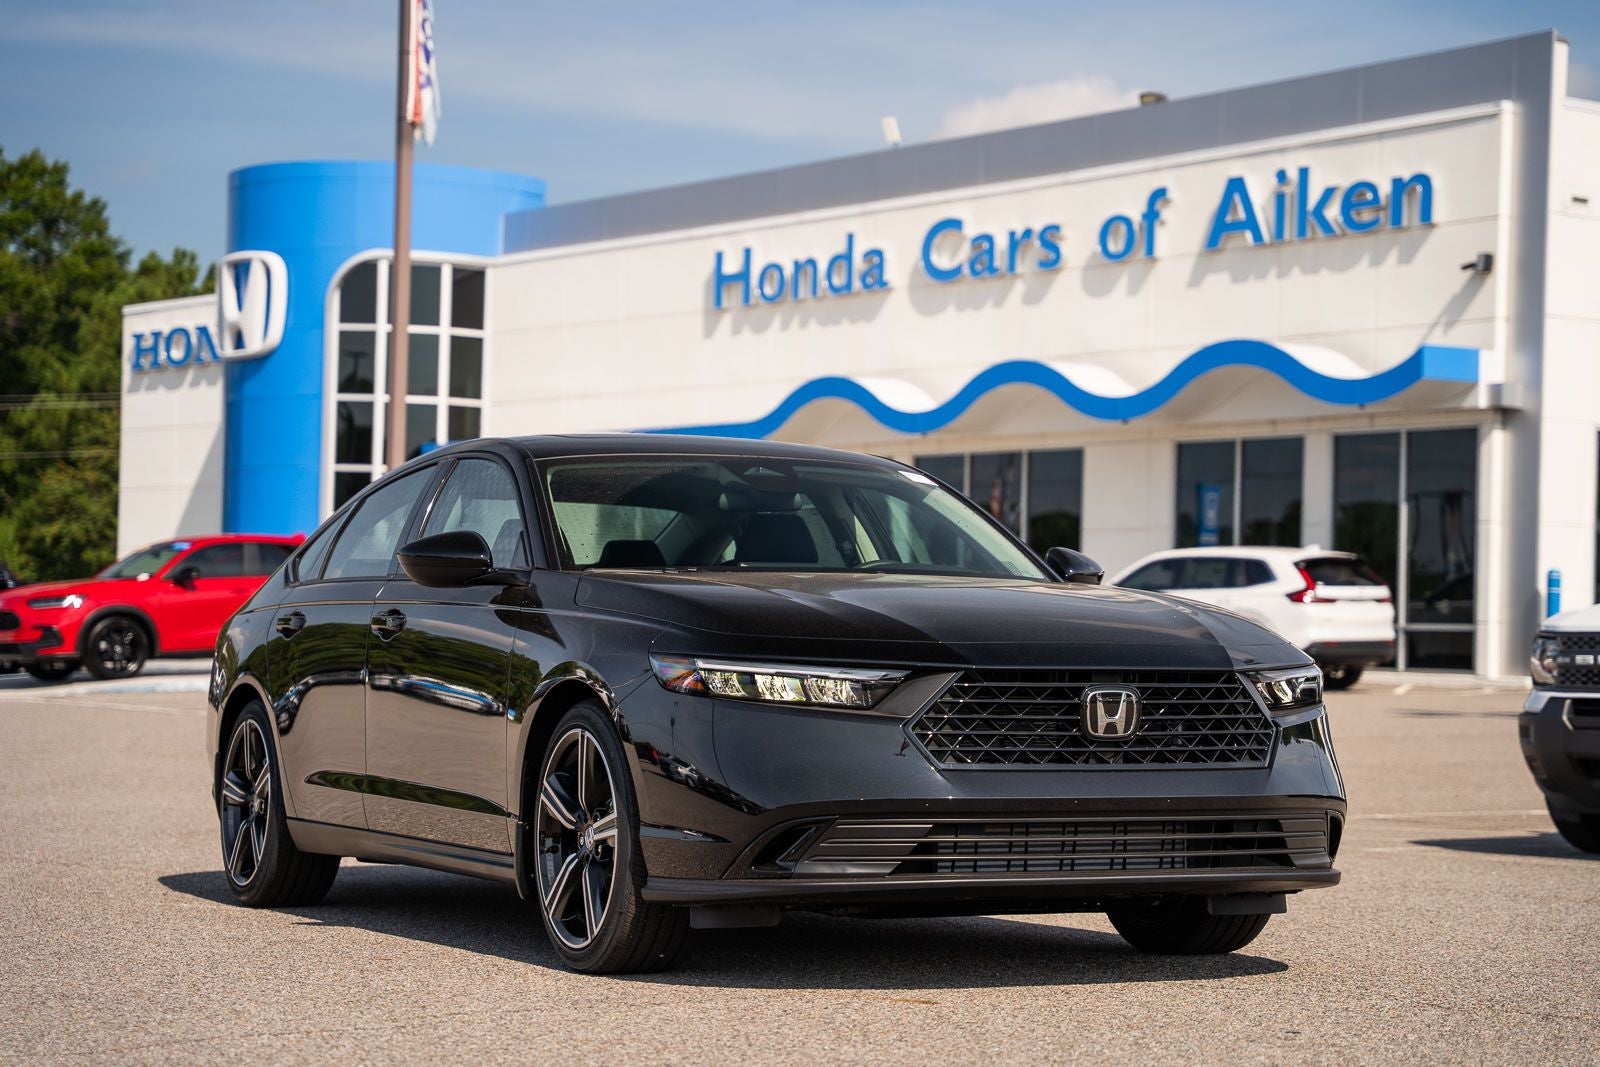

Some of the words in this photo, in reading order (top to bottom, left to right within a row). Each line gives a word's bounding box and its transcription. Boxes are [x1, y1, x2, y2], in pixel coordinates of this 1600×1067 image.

[713, 234, 888, 309] Honda
[921, 218, 1062, 283] Cars
[1098, 187, 1168, 261] of
[1205, 166, 1434, 250] Aiken
